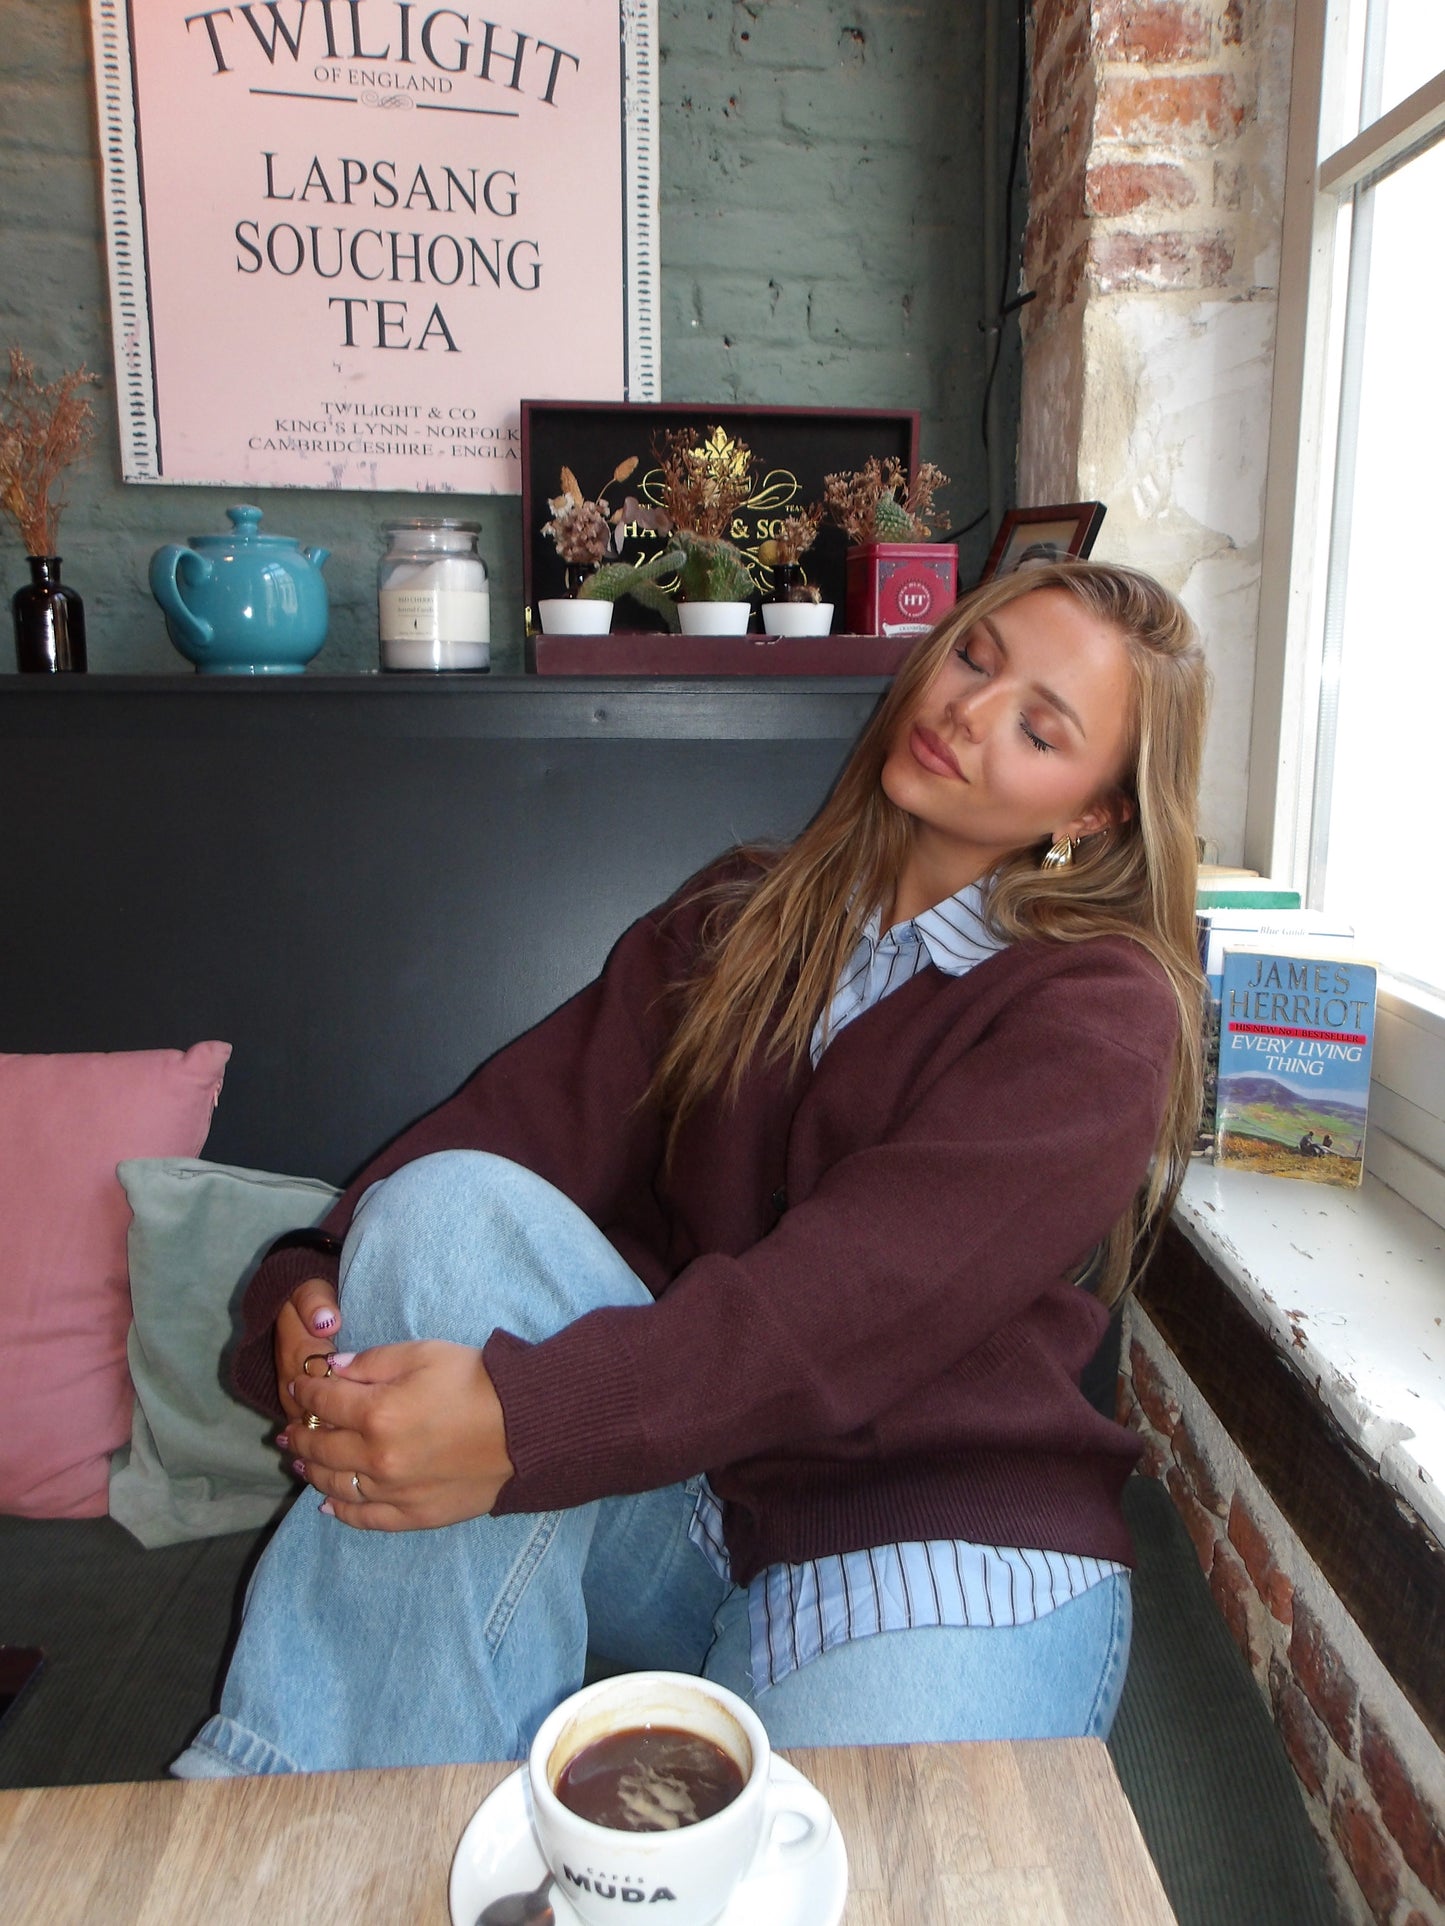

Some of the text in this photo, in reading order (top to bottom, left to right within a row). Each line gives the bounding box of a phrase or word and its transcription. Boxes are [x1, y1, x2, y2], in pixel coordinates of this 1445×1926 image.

[185, 0, 580, 107] TWILIGHT
[314, 66, 452, 94] OF ENGLAND
[260, 151, 519, 217] LAPSANG
[235, 220, 543, 290] SOUCHONG
[329, 297, 462, 352] TEA
[321, 401, 476, 420] TWILIGHT & CO
[275, 419, 346, 436] KING'S
[353, 423, 408, 437] LYNN
[427, 425, 519, 441] NORFOLK
[452, 444, 521, 459] ENGLA
[730, 518, 750, 538] &
[904, 594, 926, 605] HT
[1248, 959, 1350, 995] JAMES
[1229, 989, 1369, 1029] HERRIOT
[1235, 1023, 1253, 1033] HIS
[1253, 1025, 1276, 1035] NEW
[1301, 1029, 1359, 1043] BESTSELLER
[1231, 1035, 1362, 1062] EVERY LIVING
[1265, 1055, 1325, 1076] THING
[563, 1863, 677, 1903] MUDA
